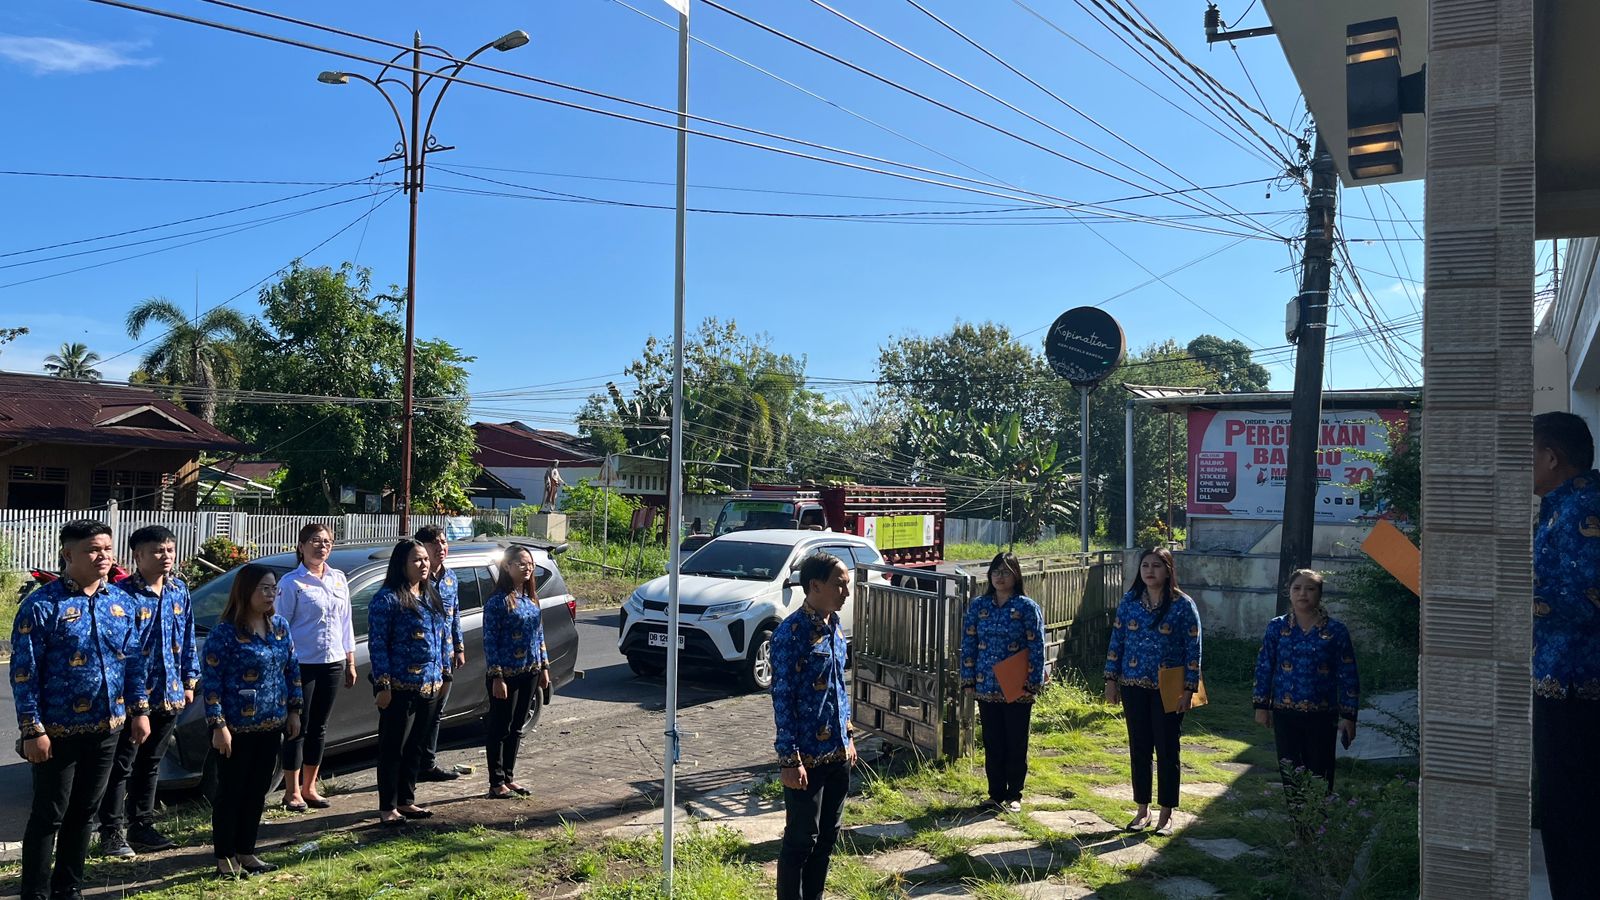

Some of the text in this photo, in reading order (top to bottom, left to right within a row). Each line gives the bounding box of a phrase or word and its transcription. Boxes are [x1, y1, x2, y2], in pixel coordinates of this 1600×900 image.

[1054, 321, 1116, 350] Kopination
[1225, 420, 1365, 446] PERCKAN
[650, 633, 657, 641] DB
